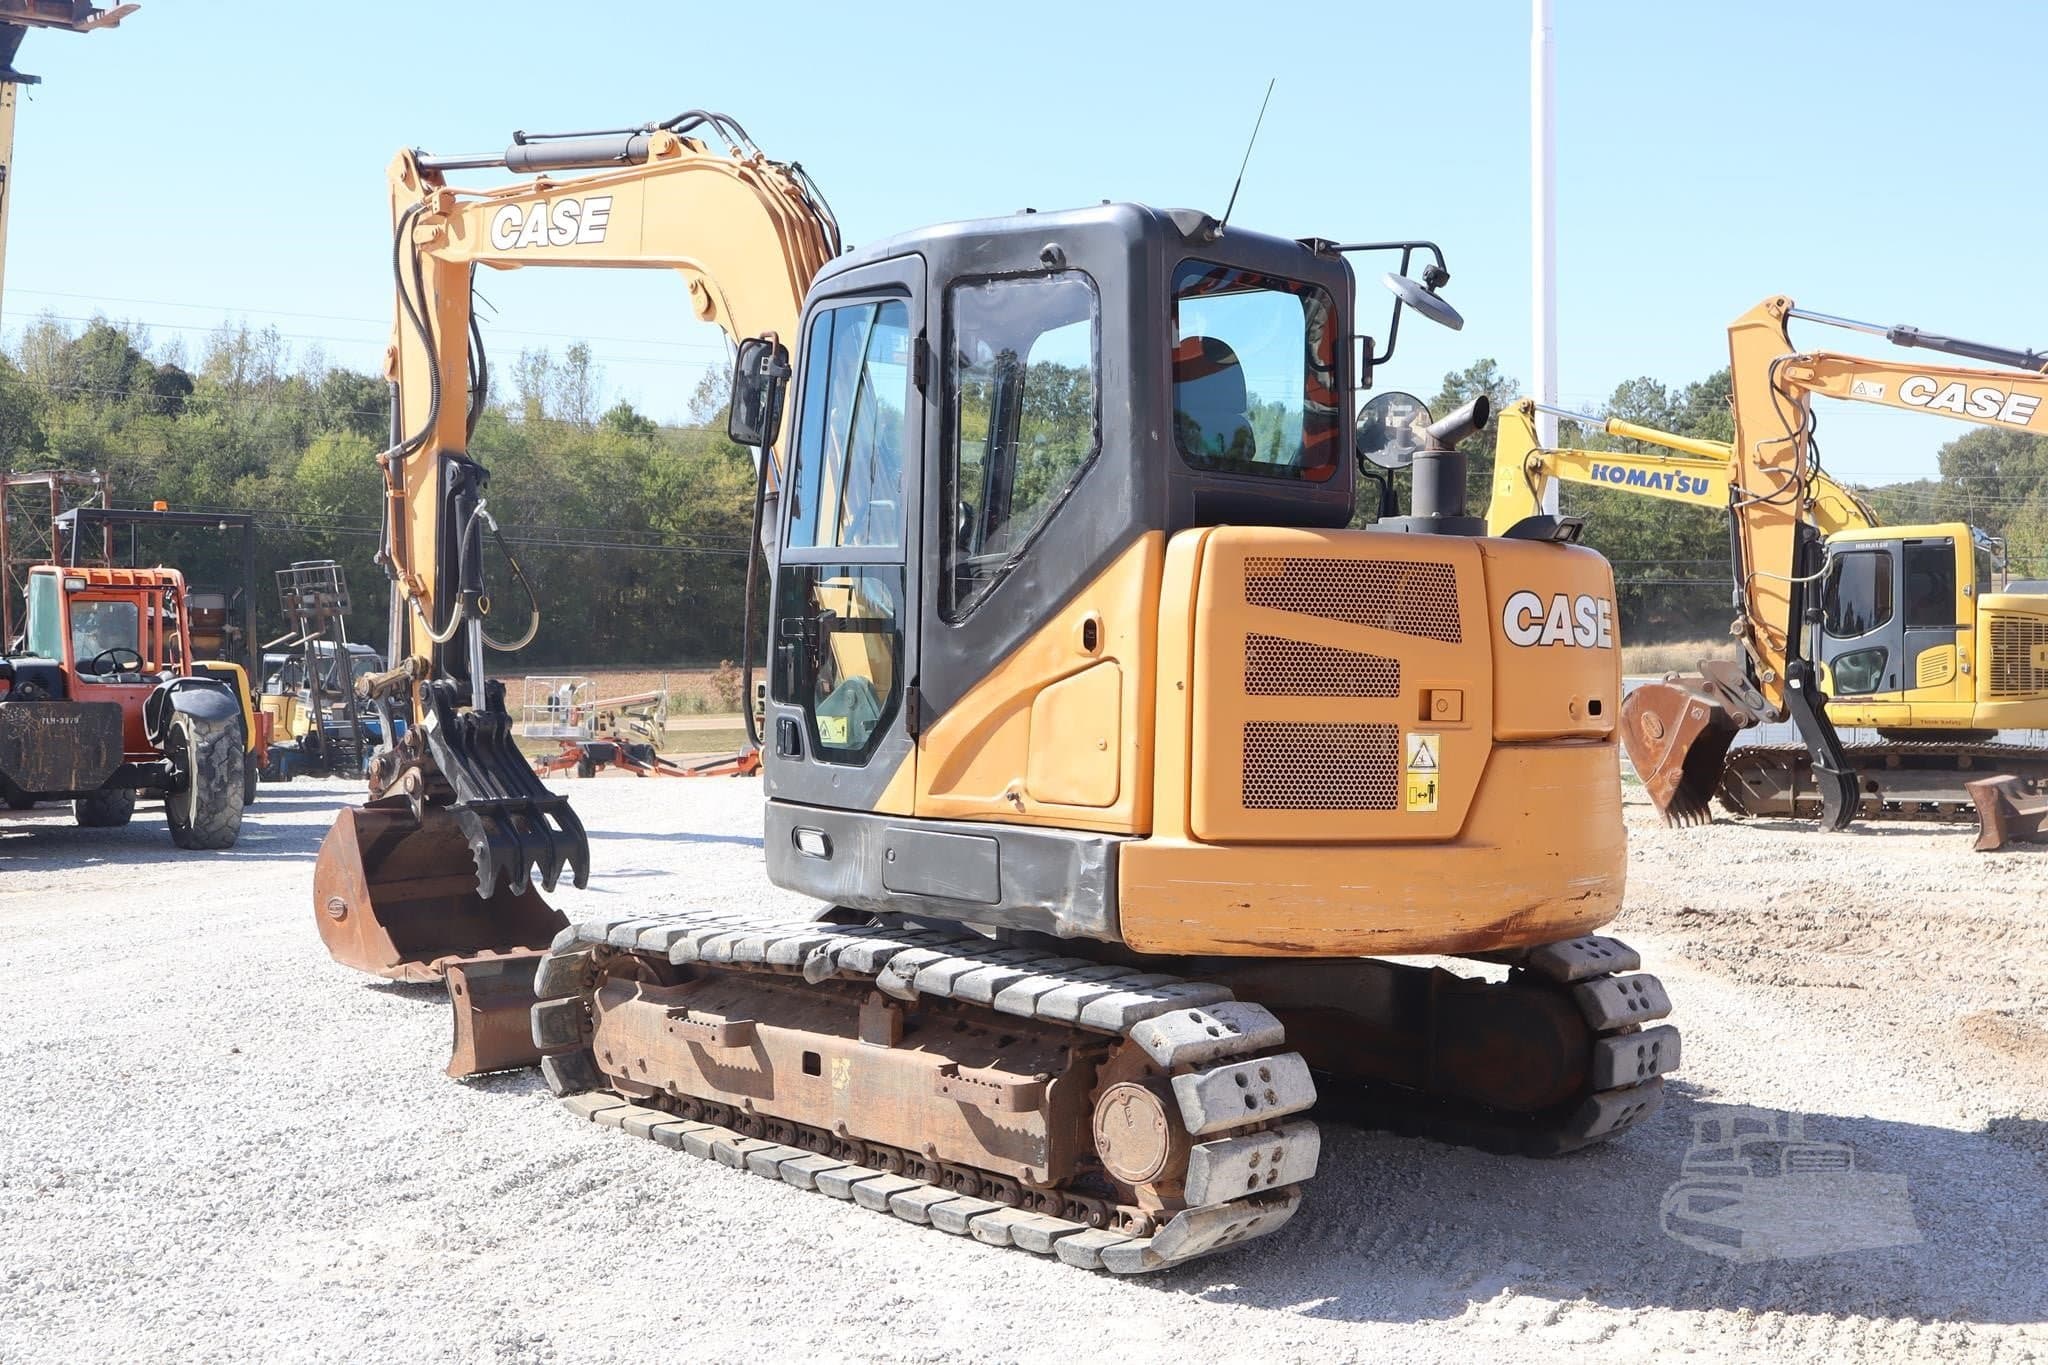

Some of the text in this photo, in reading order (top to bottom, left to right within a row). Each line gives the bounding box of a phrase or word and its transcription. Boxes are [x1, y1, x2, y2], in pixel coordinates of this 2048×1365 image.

[491, 196, 613, 251] CASE
[1899, 375, 2042, 426] CASE
[1591, 463, 1709, 496] KOMATSU
[1502, 590, 1612, 649] CASE
